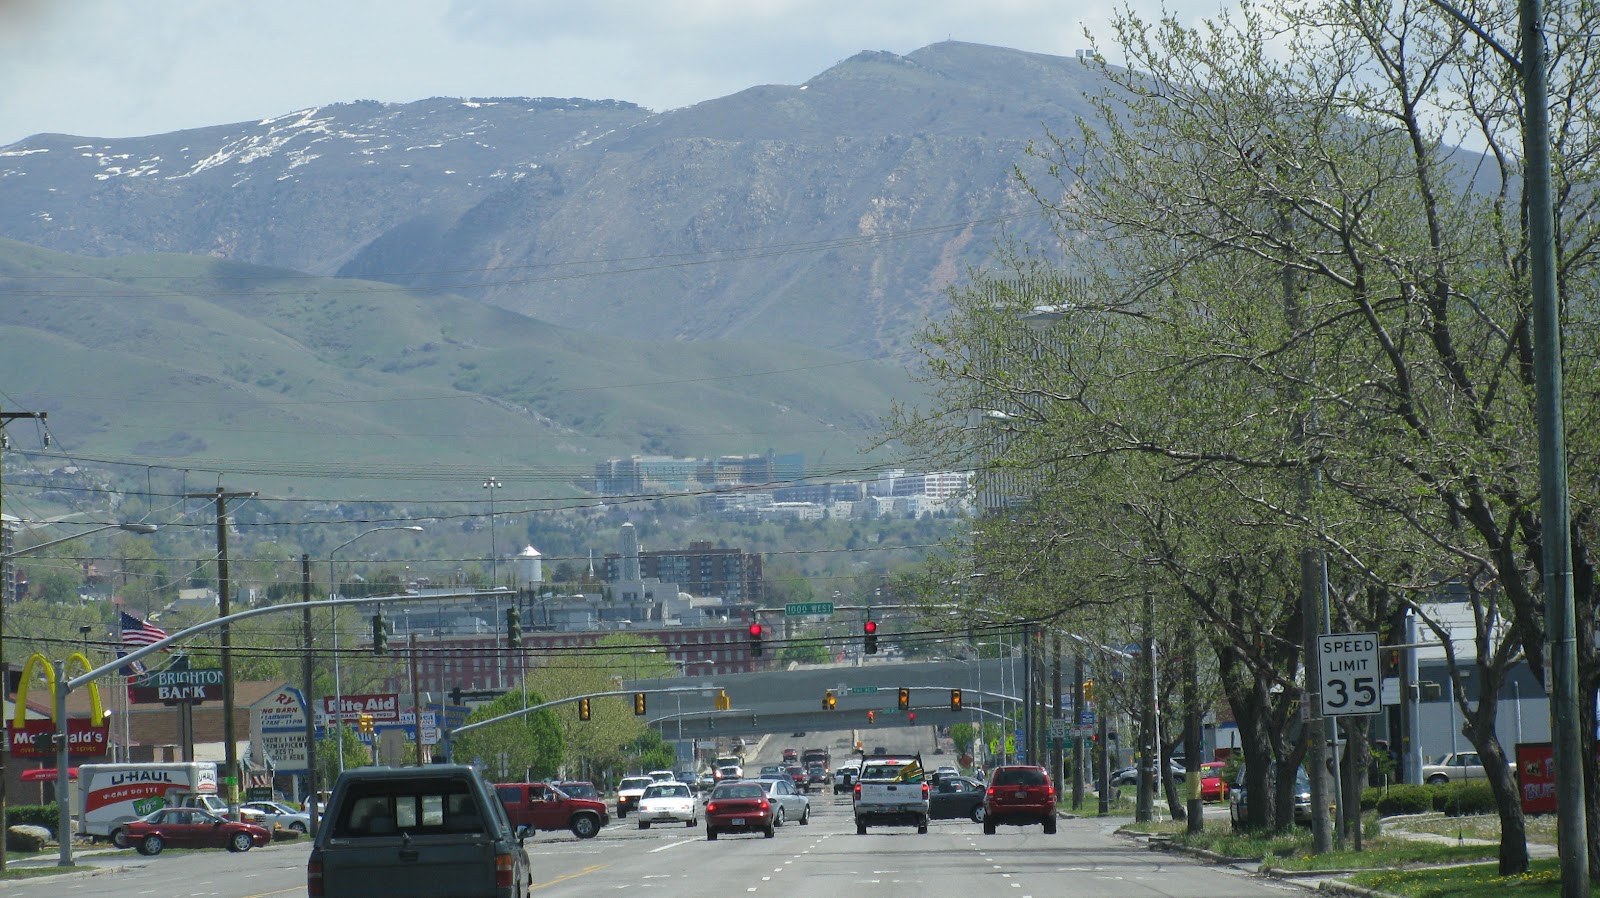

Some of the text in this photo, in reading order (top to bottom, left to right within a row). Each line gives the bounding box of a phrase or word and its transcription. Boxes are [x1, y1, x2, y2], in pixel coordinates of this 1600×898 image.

[787, 604, 831, 614] 1000 WEST
[1323, 640, 1374, 653] SPEED
[1330, 659, 1369, 672] LIMIT
[159, 670, 224, 686] BRIGHTON
[158, 685, 206, 699] BANK
[1327, 677, 1376, 708] 35
[327, 696, 395, 712] Rite Aid
[261, 707, 273, 715] NG
[13, 731, 103, 744] Mcoald's
[1052, 728, 1064, 736] 35
[111, 771, 172, 785] U-HAUL
